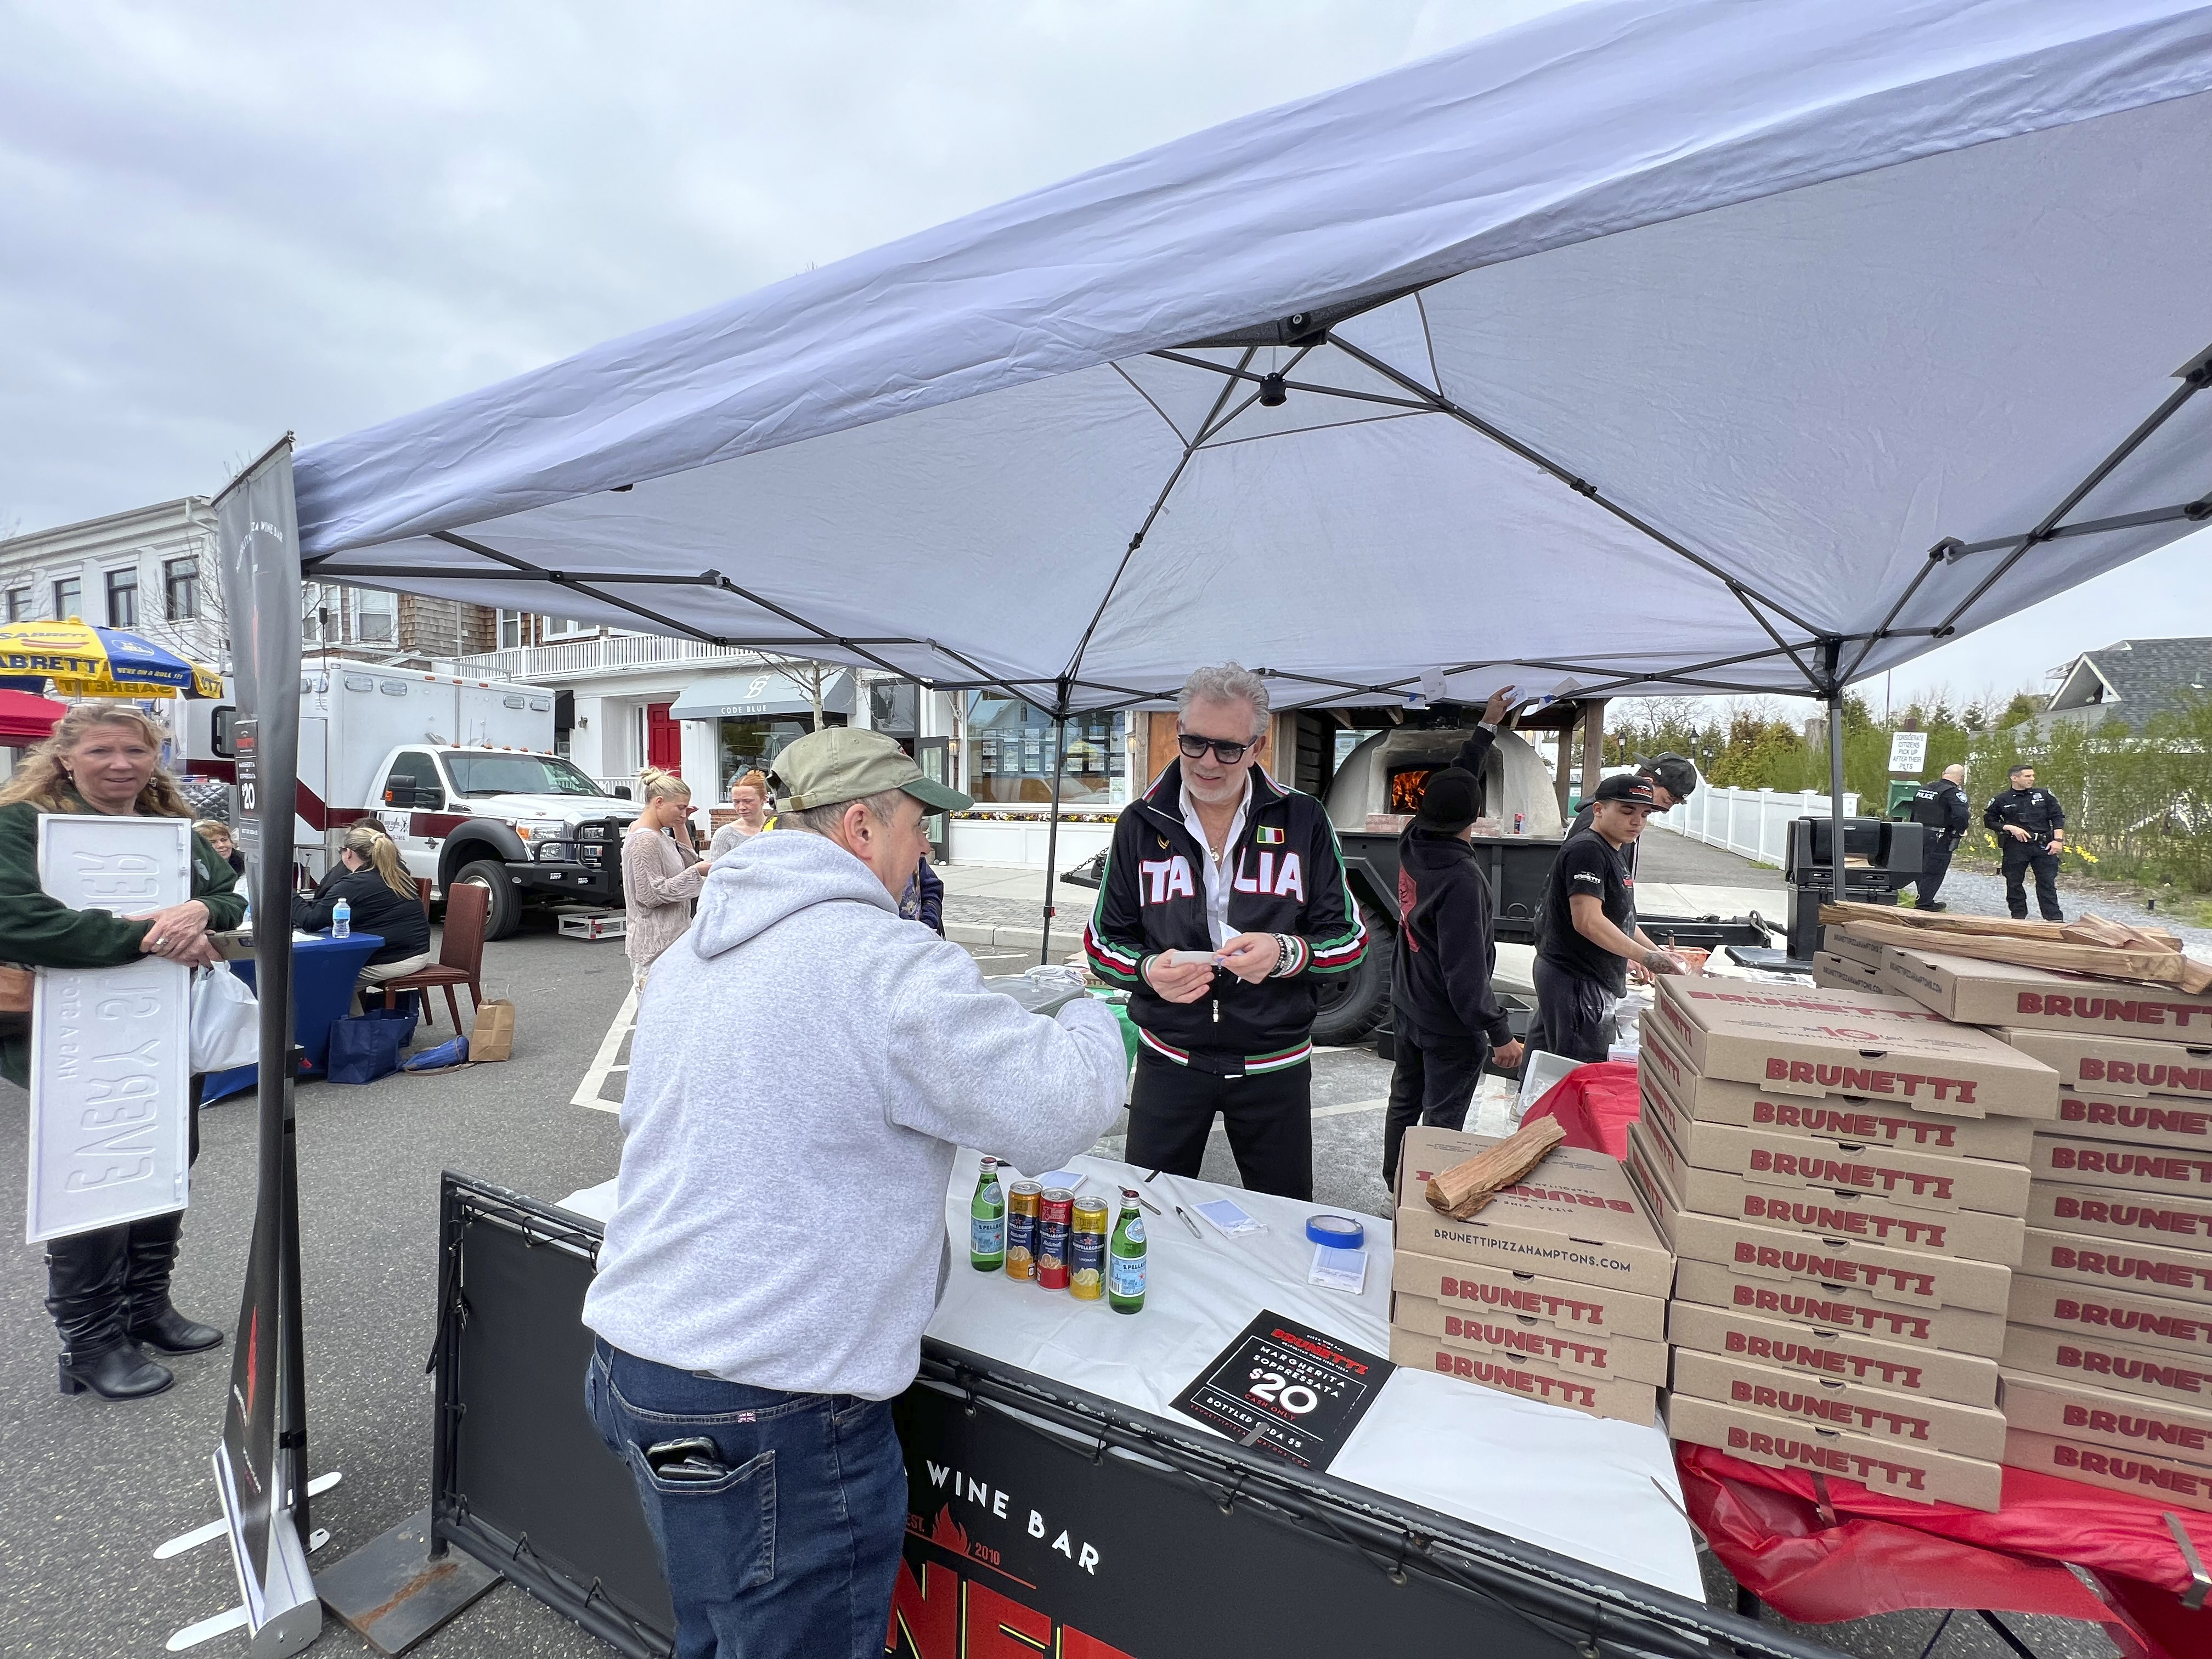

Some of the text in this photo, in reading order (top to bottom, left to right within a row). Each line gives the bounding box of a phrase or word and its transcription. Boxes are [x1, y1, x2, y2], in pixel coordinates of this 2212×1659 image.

[721, 704, 767, 715] CODE BLUE
[241, 782, 256, 810] $20
[1915, 792, 1935, 800] POLICE
[1686, 990, 1946, 1023] BRUNETTI
[1766, 1057, 1977, 1104] BRUNETTI
[1753, 1101, 1956, 1147] BRUNETTI
[2060, 1099, 2212, 1135] BRUNE
[1750, 1149, 1954, 1199] BRUNETTI
[1503, 1200, 1574, 1214] PIZZA WINE
[1744, 1194, 1946, 1247] BRUNETTI
[1434, 1228, 1632, 1273] BRUNETTIPIZZAHAMPTONS.COM
[1734, 1242, 1936, 1296] BRUNETTI
[1441, 1276, 1604, 1325] BRUNETTI
[1733, 1284, 1931, 1340] BRUNETTI
[1270, 1328, 1369, 1376] BRUNETTI
[1445, 1315, 1607, 1368] BRUNETTI
[1725, 1330, 1923, 1388] BRUNETTI
[1248, 1367, 1318, 1415] $20
[1252, 1354, 1340, 1398] SOPPRESSATA
[1260, 1345, 1346, 1389] MARGHERITA
[1435, 1351, 1595, 1408] BRUNETTI
[2056, 1345, 2212, 1395] BRUNE
[1205, 1396, 1253, 1424] BOTTLED
[1255, 1421, 1284, 1441] SDA
[1244, 1393, 1296, 1421] CASH ONLY
[1731, 1380, 1930, 1441] BRUNETTI
[2063, 1404, 2212, 1450] BRUNE
[1190, 1404, 1309, 1468] BRUNETTIPIZZAMPTONS.COM
[1728, 1426, 1926, 1491] BRUNETTI
[905, 1512, 1001, 1566] EST. 2010
[926, 1459, 1101, 1576] WINE BAR
